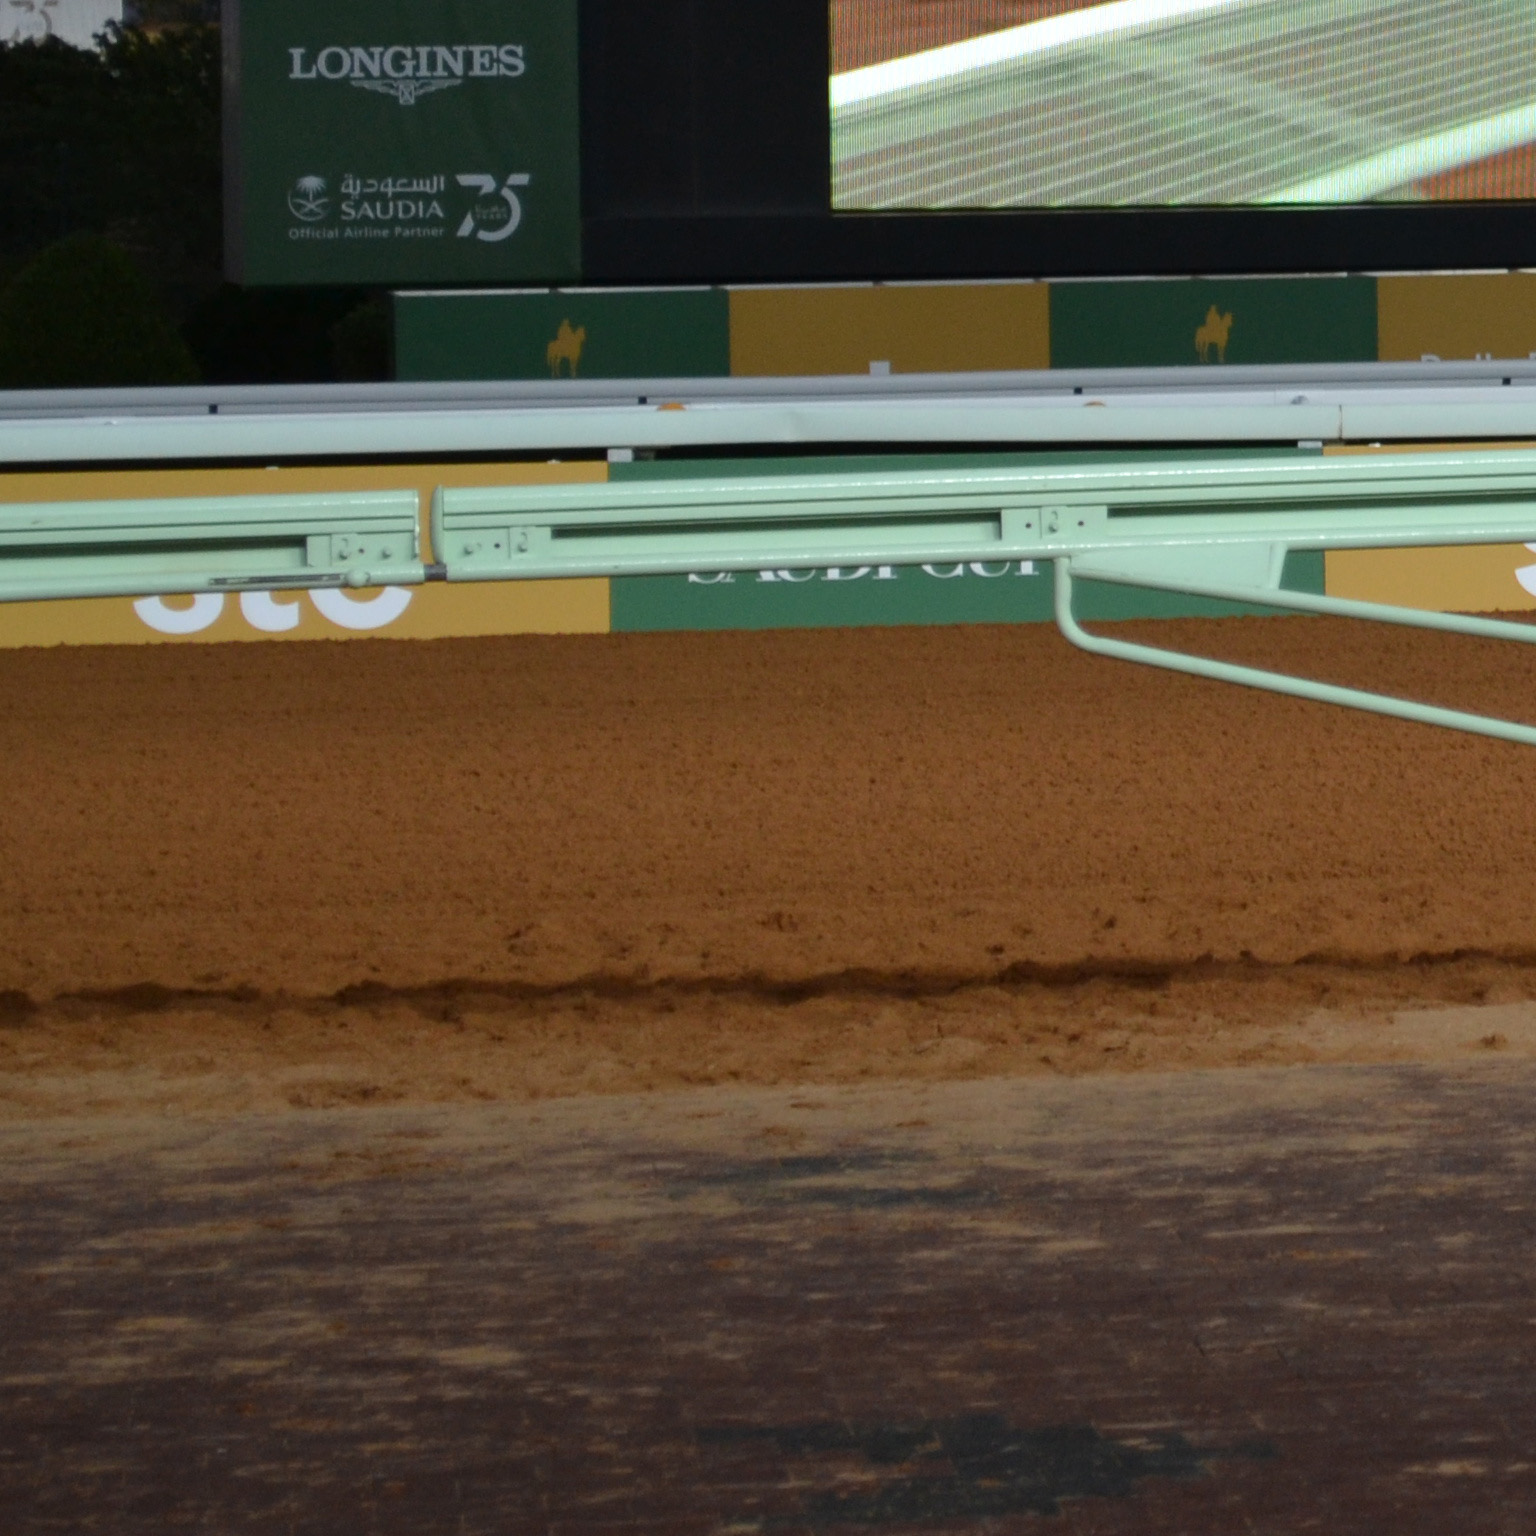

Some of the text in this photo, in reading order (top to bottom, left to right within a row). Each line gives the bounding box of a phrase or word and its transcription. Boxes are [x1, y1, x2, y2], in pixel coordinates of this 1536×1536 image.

[289, 45, 525, 80] LONGINES
[341, 173, 446, 199] السعودية
[341, 200, 445, 221] SAUDIA
[455, 172, 531, 243] 75
[289, 226, 445, 240] Official Airline Partner
